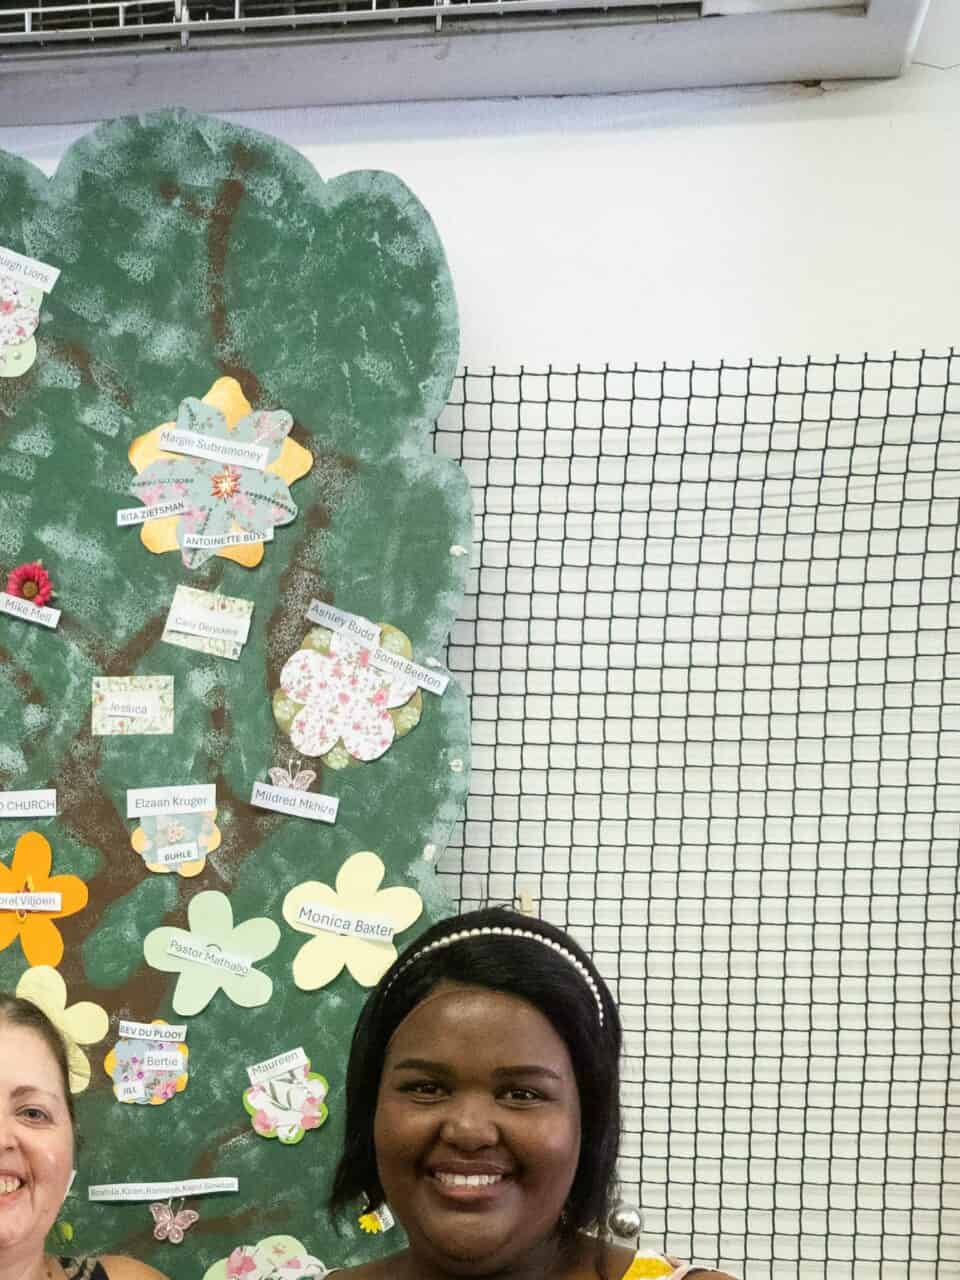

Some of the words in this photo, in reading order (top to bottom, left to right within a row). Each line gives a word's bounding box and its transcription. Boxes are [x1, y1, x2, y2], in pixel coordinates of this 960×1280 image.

[23, 266, 50, 283] Lions
[196, 438, 264, 462] Subramoney
[185, 532, 241, 546] ANTOINETTE
[311, 603, 347, 627] Ashley
[348, 619, 376, 641] Budd
[373, 649, 404, 672] Sonet
[404, 662, 442, 689] Beeton
[6, 799, 55, 811] CHURCH
[135, 797, 170, 809] Elzaan
[172, 796, 208, 809] Kruger
[255, 788, 297, 807] Mildred
[298, 906, 352, 930] Monica
[354, 919, 394, 937] Baxter
[170, 939, 202, 958] Pastor
[138, 1028, 153, 1038] DU
[153, 1030, 184, 1040] PLOOY
[146, 1055, 178, 1066] Bertie
[251, 1051, 300, 1076] Maureen
